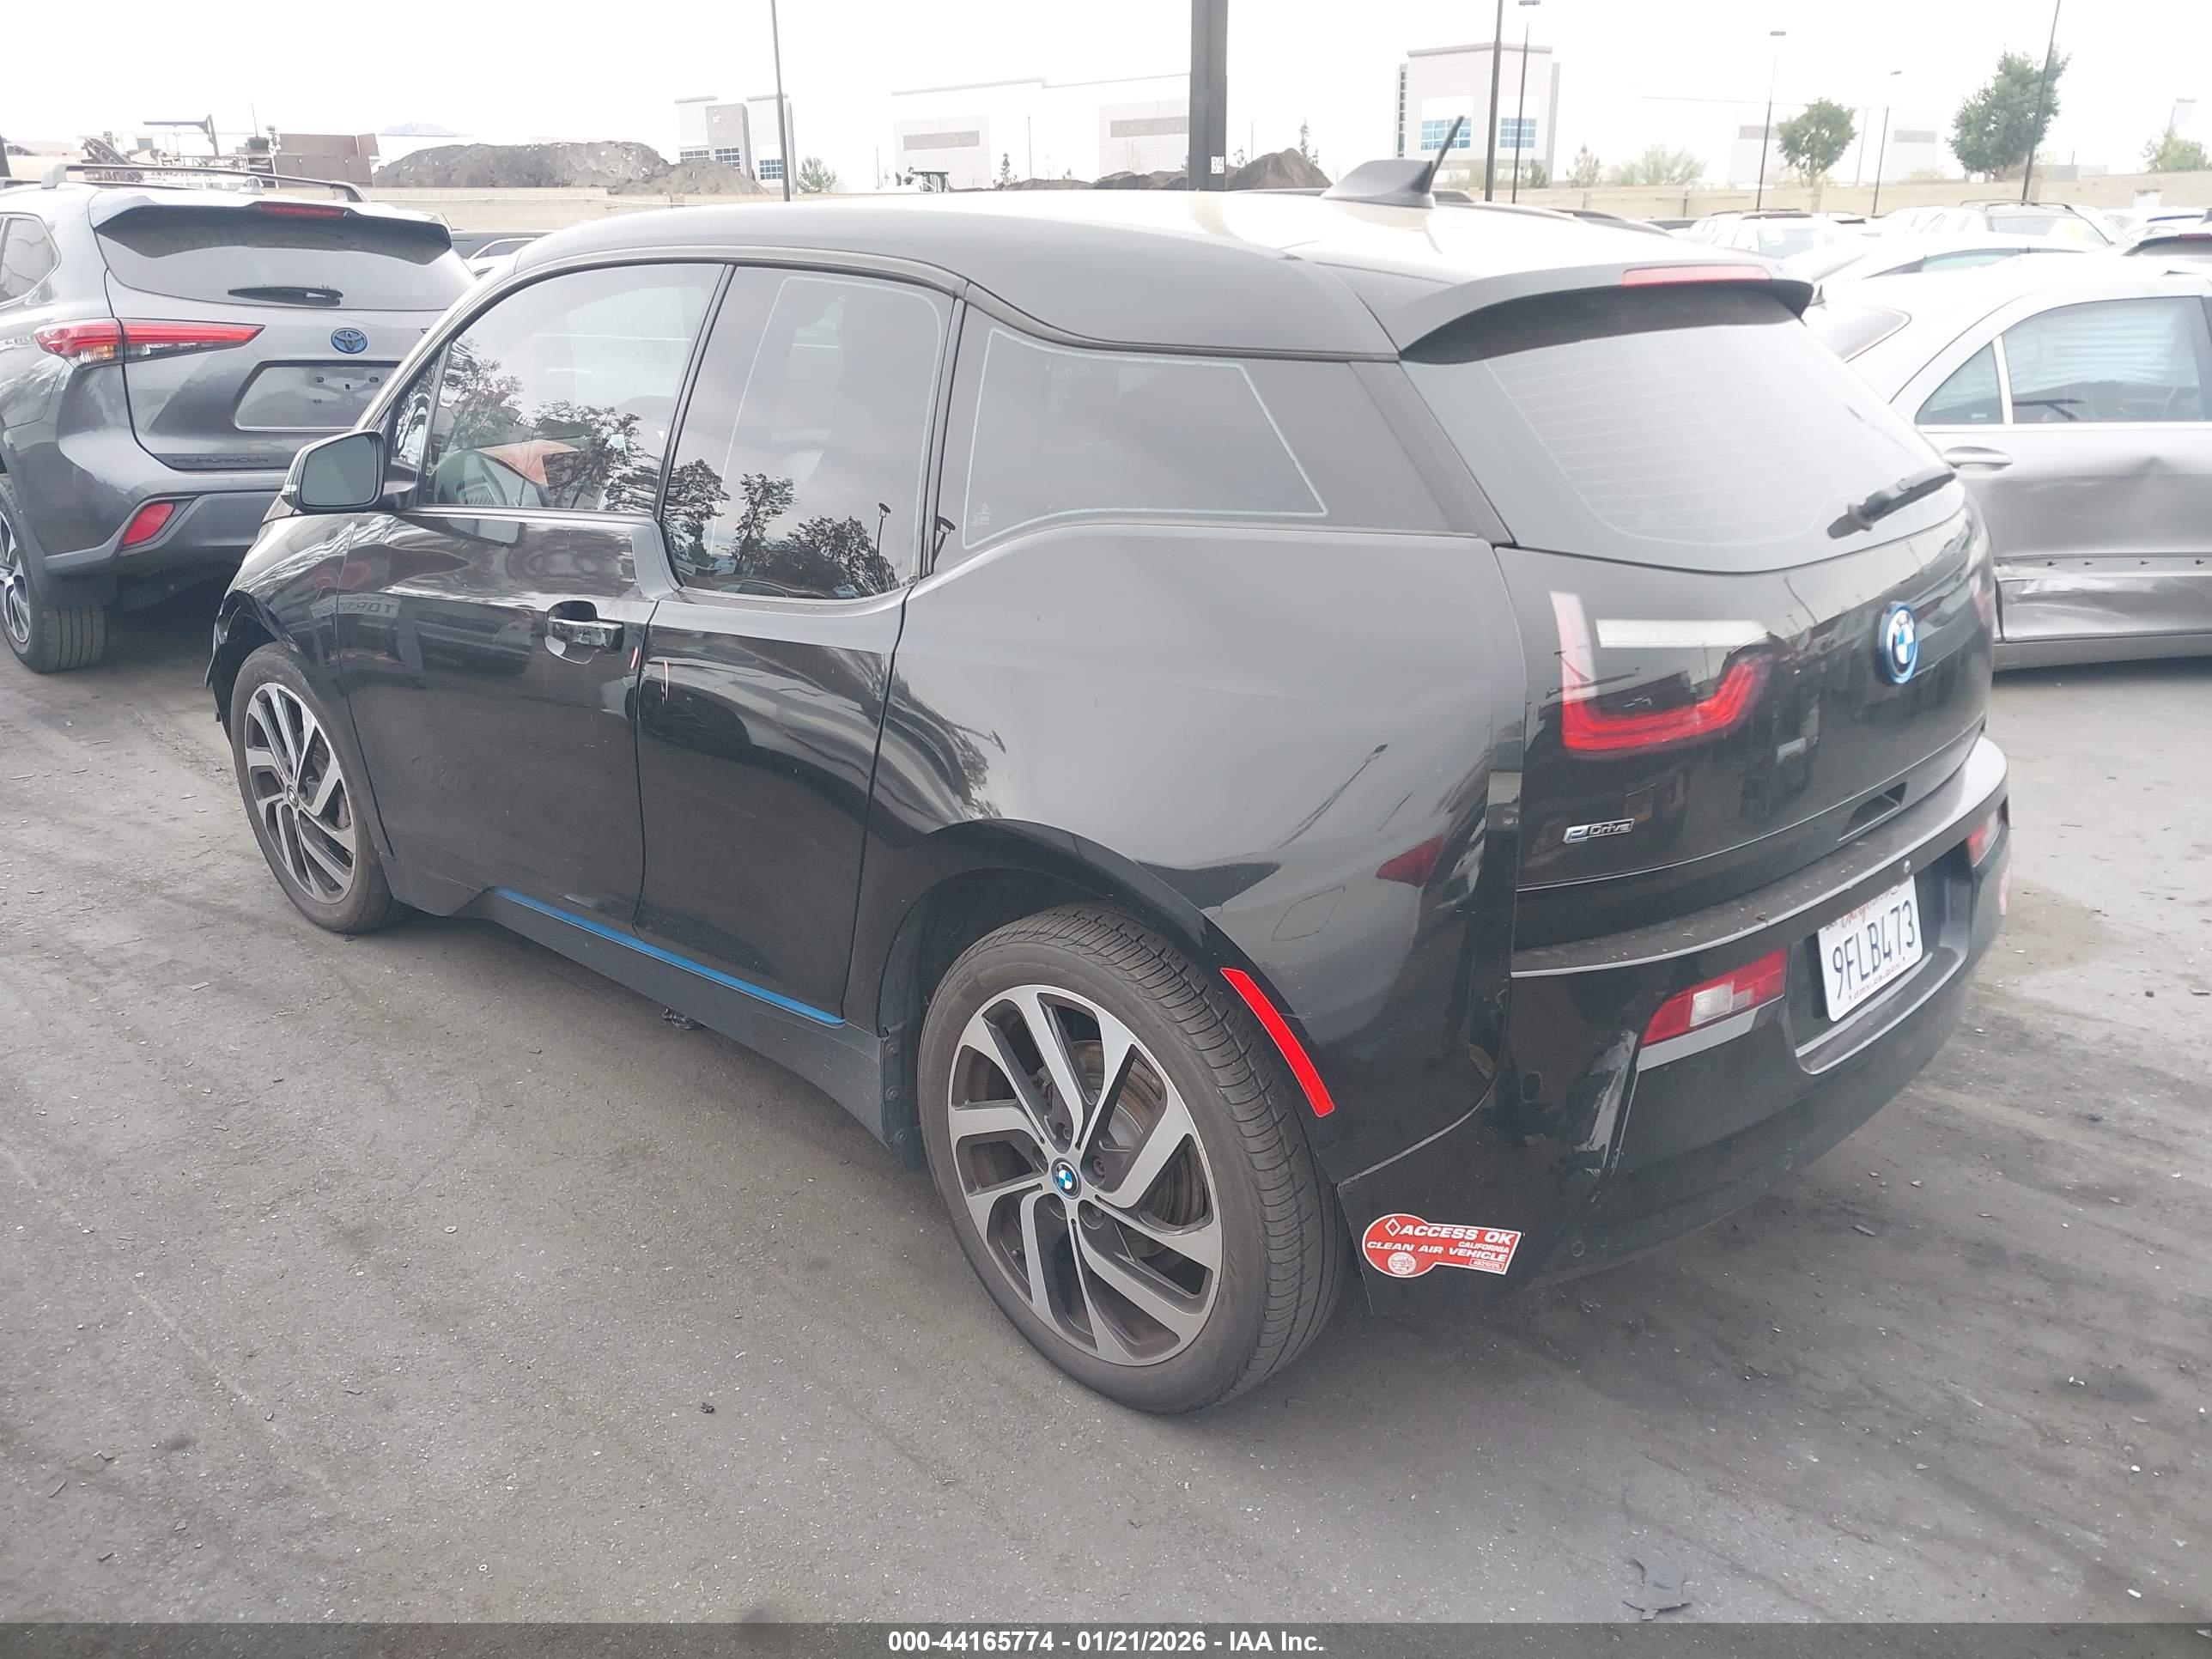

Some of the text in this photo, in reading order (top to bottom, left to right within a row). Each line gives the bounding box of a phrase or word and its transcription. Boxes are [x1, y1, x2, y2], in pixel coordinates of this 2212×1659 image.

[1832, 899, 1915, 1000] 9FLB473
[1399, 1224, 1516, 1245] ACCESS OK
[1366, 1241, 1509, 1262] CLEAN AIR VEHICLE
[1458, 1242, 1510, 1254] CALIFORNIA
